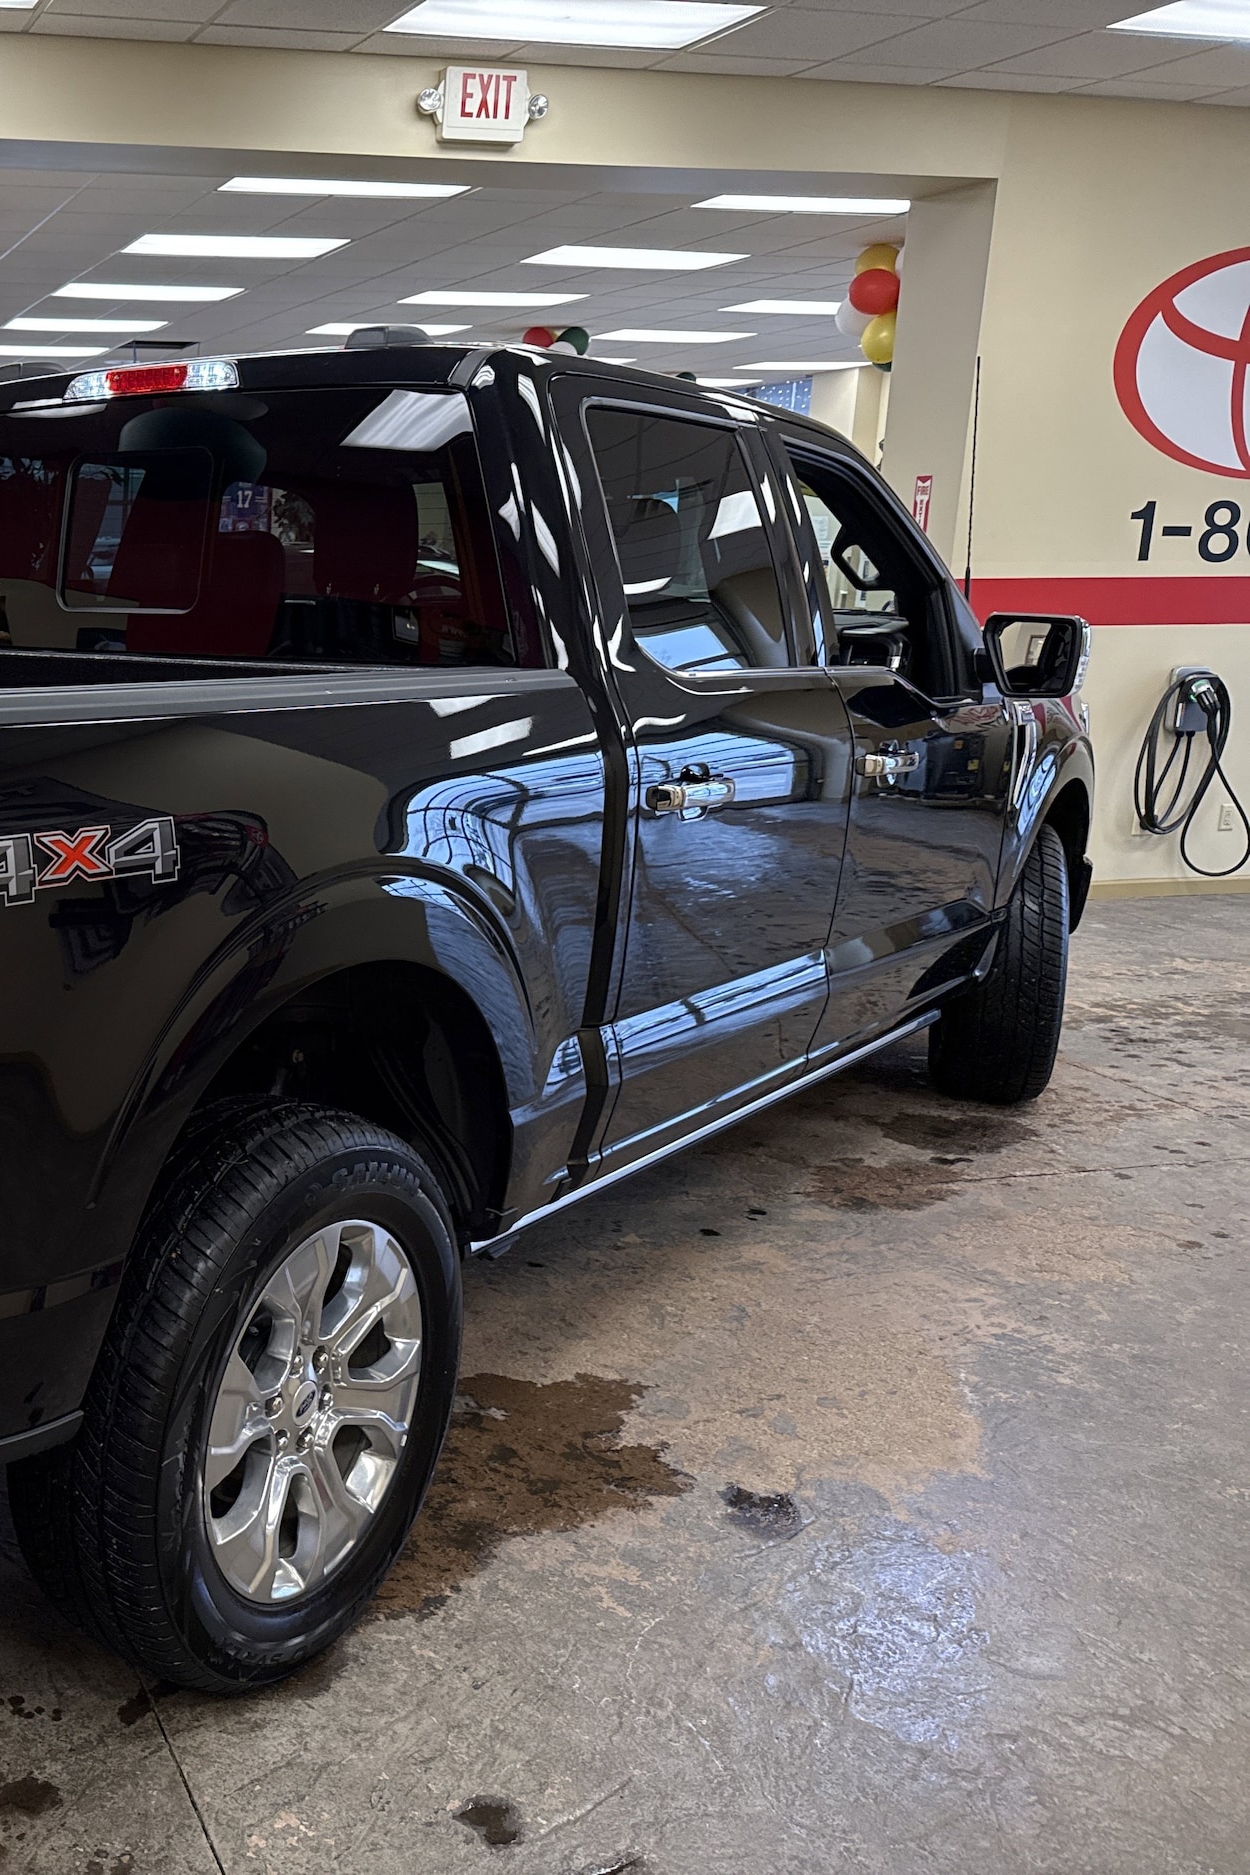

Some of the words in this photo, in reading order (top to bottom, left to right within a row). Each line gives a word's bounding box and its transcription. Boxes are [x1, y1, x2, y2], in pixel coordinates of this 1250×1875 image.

[460, 72, 518, 120] EXIT
[237, 490, 253, 509] 17
[1130, 500, 1250, 563] 1-8
